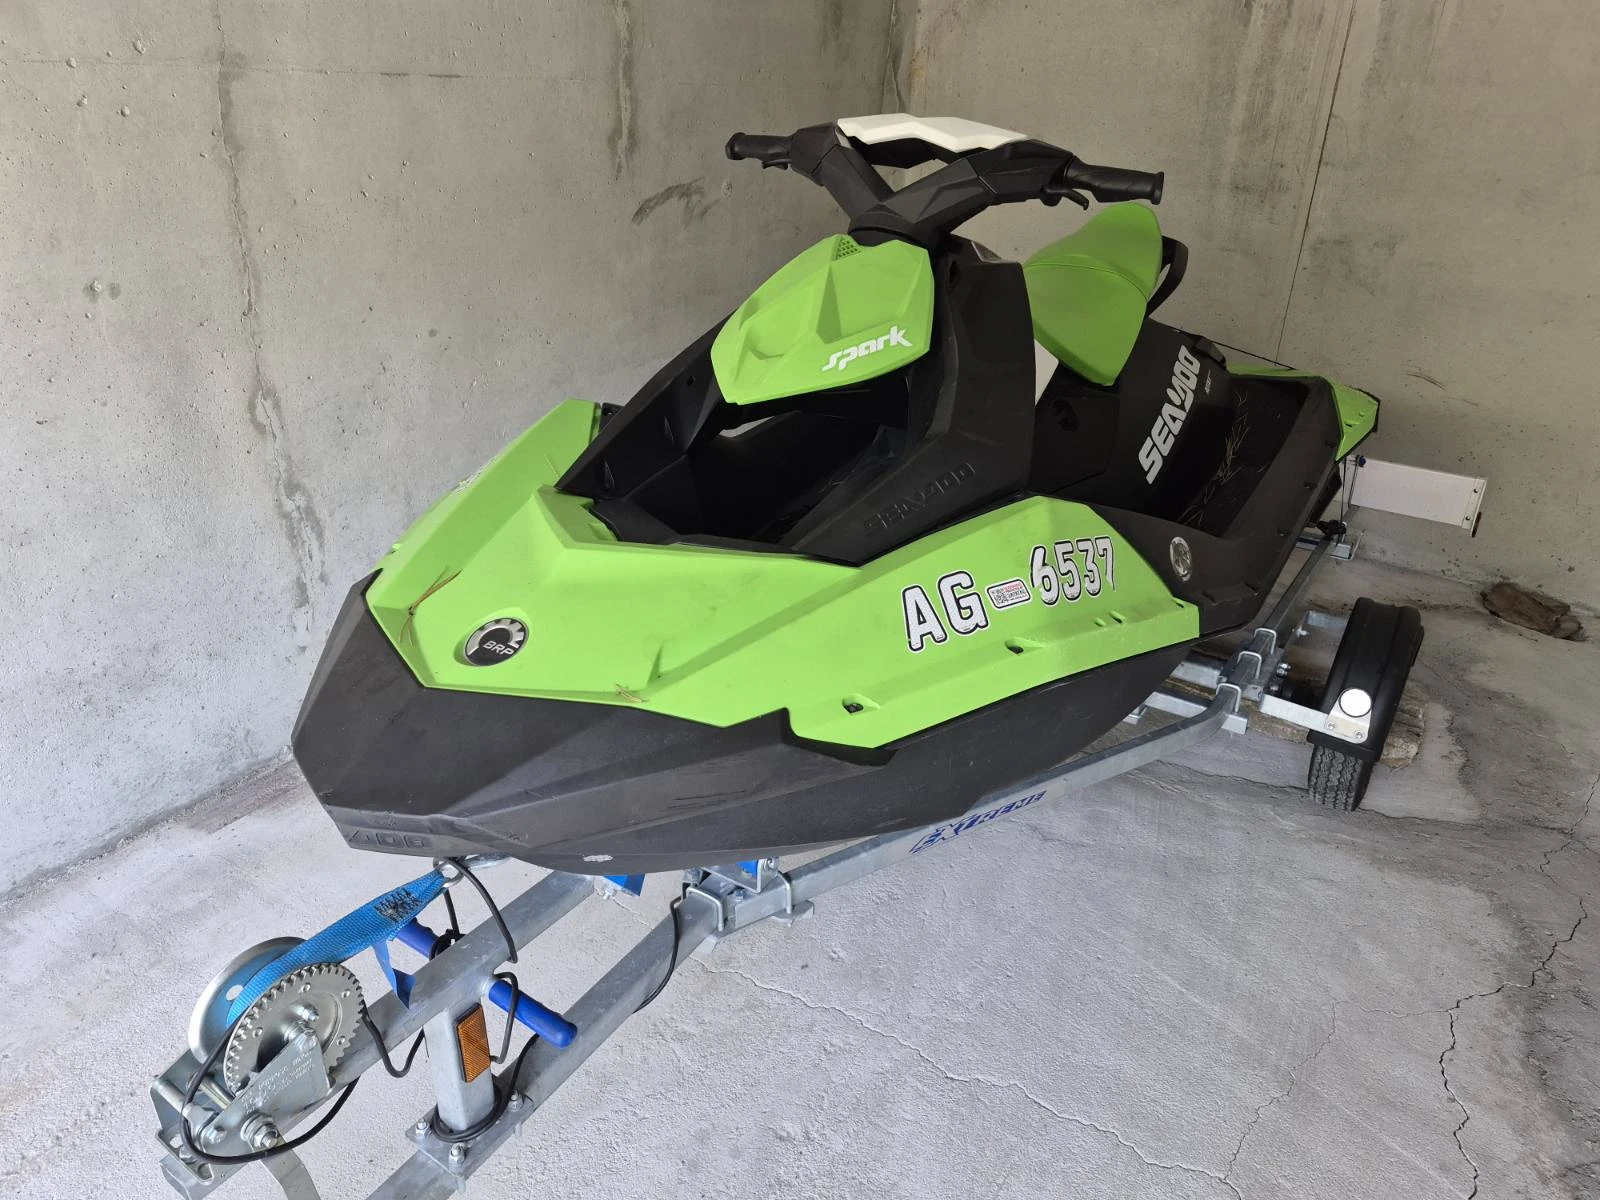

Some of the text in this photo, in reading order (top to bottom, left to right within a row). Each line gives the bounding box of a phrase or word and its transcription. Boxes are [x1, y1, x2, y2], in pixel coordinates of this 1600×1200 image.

[902, 535, 1116, 652] AG 6537
[482, 640, 514, 655] BRP
